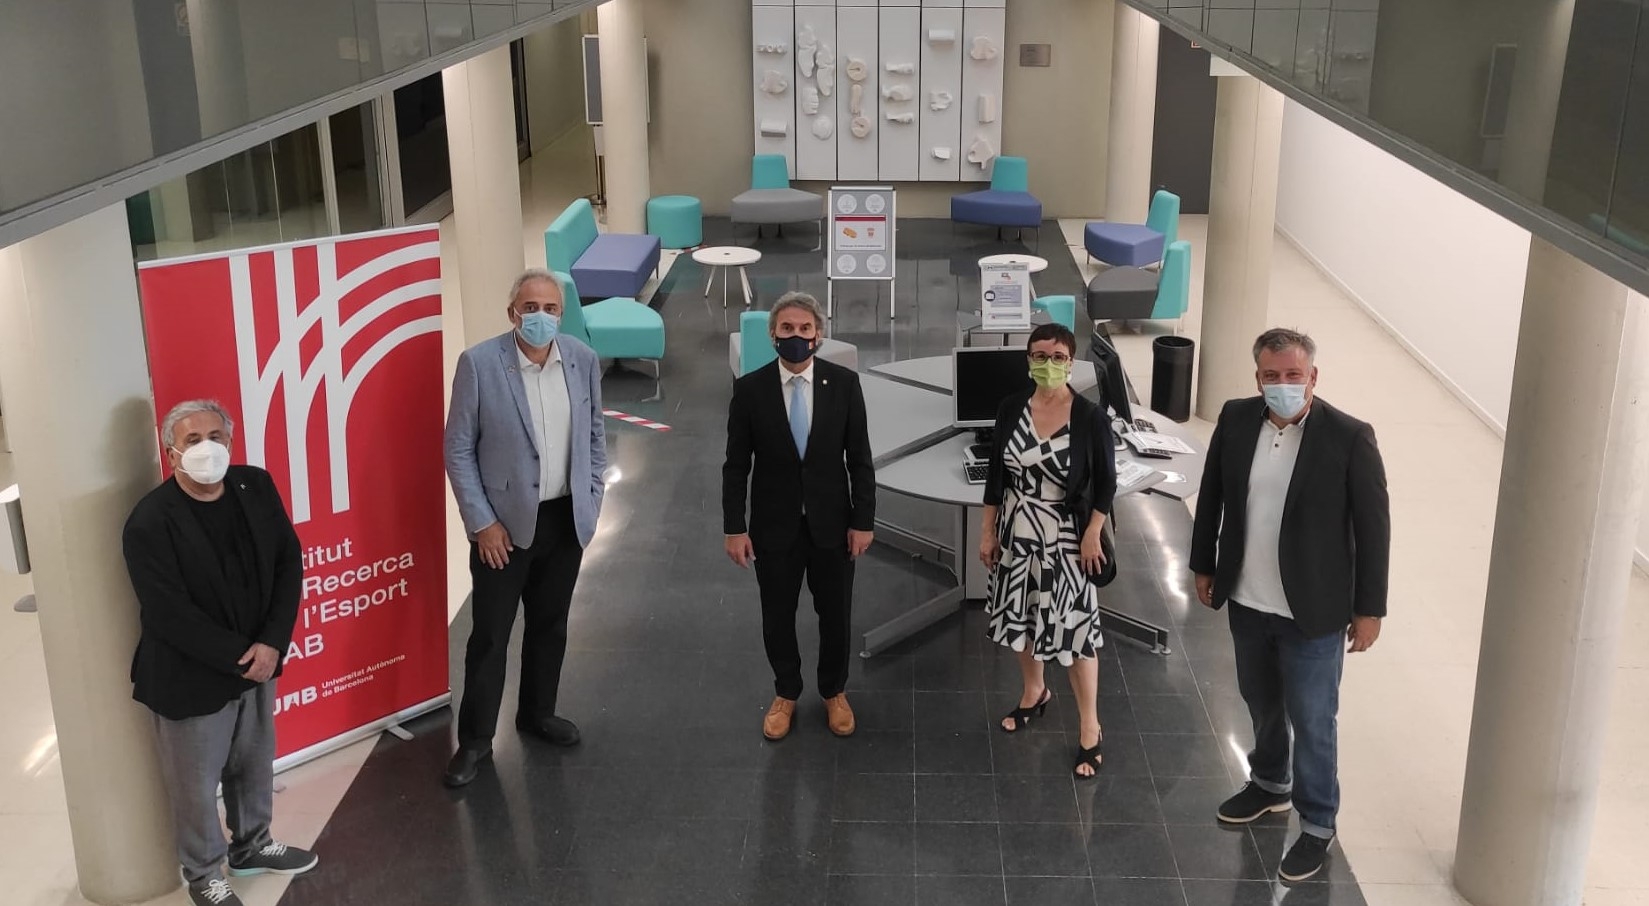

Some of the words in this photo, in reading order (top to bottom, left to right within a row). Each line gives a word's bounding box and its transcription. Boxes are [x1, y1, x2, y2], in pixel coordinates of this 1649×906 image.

[302, 537, 353, 570] titut
[302, 551, 415, 600] Recerca
[304, 578, 408, 629] l'Esport
[283, 633, 324, 665] AB
[321, 668, 365, 689] Universitat
[322, 688, 333, 698] de
[333, 674, 375, 694] Barcelona
